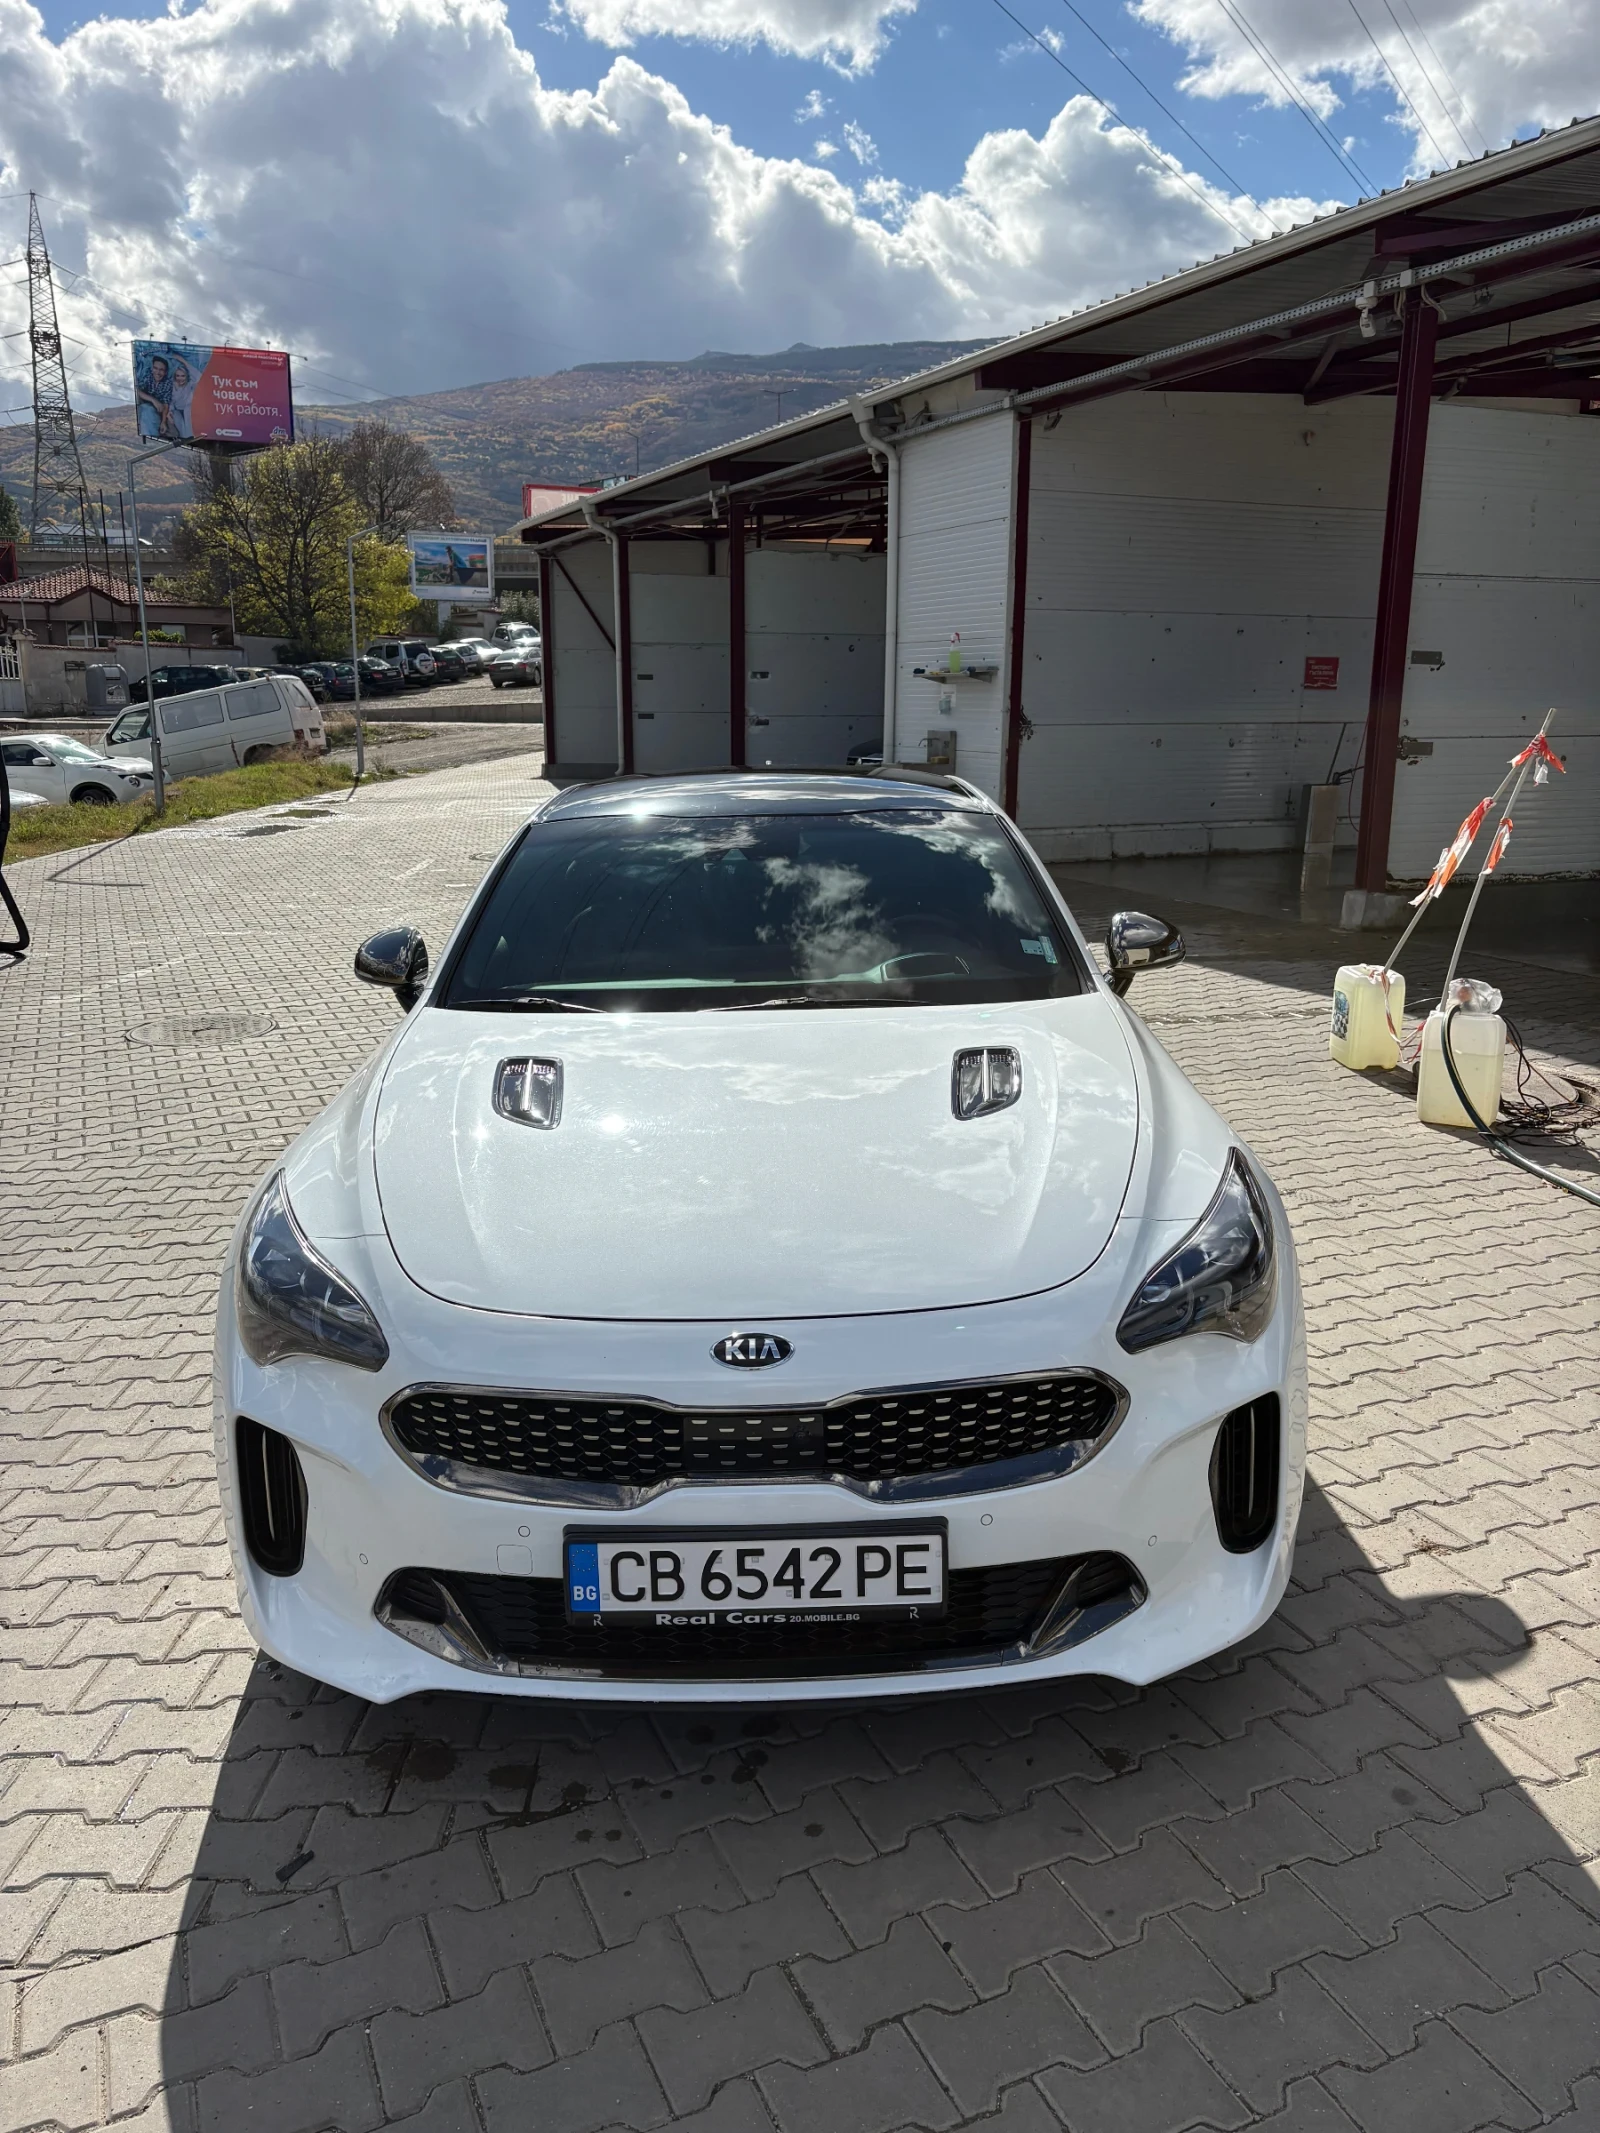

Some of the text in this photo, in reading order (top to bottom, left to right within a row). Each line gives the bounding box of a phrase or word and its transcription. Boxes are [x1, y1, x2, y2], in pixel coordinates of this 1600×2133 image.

[212, 375, 258, 389] Тук съм
[213, 390, 254, 403] човек,
[214, 403, 282, 417] тук работя.
[724, 1338, 781, 1361] KIA
[610, 1544, 932, 1602] CB 6542 PE
[573, 1586, 597, 1601] BG
[655, 1612, 861, 1626] Real Cars 20.MOBILE.BG
